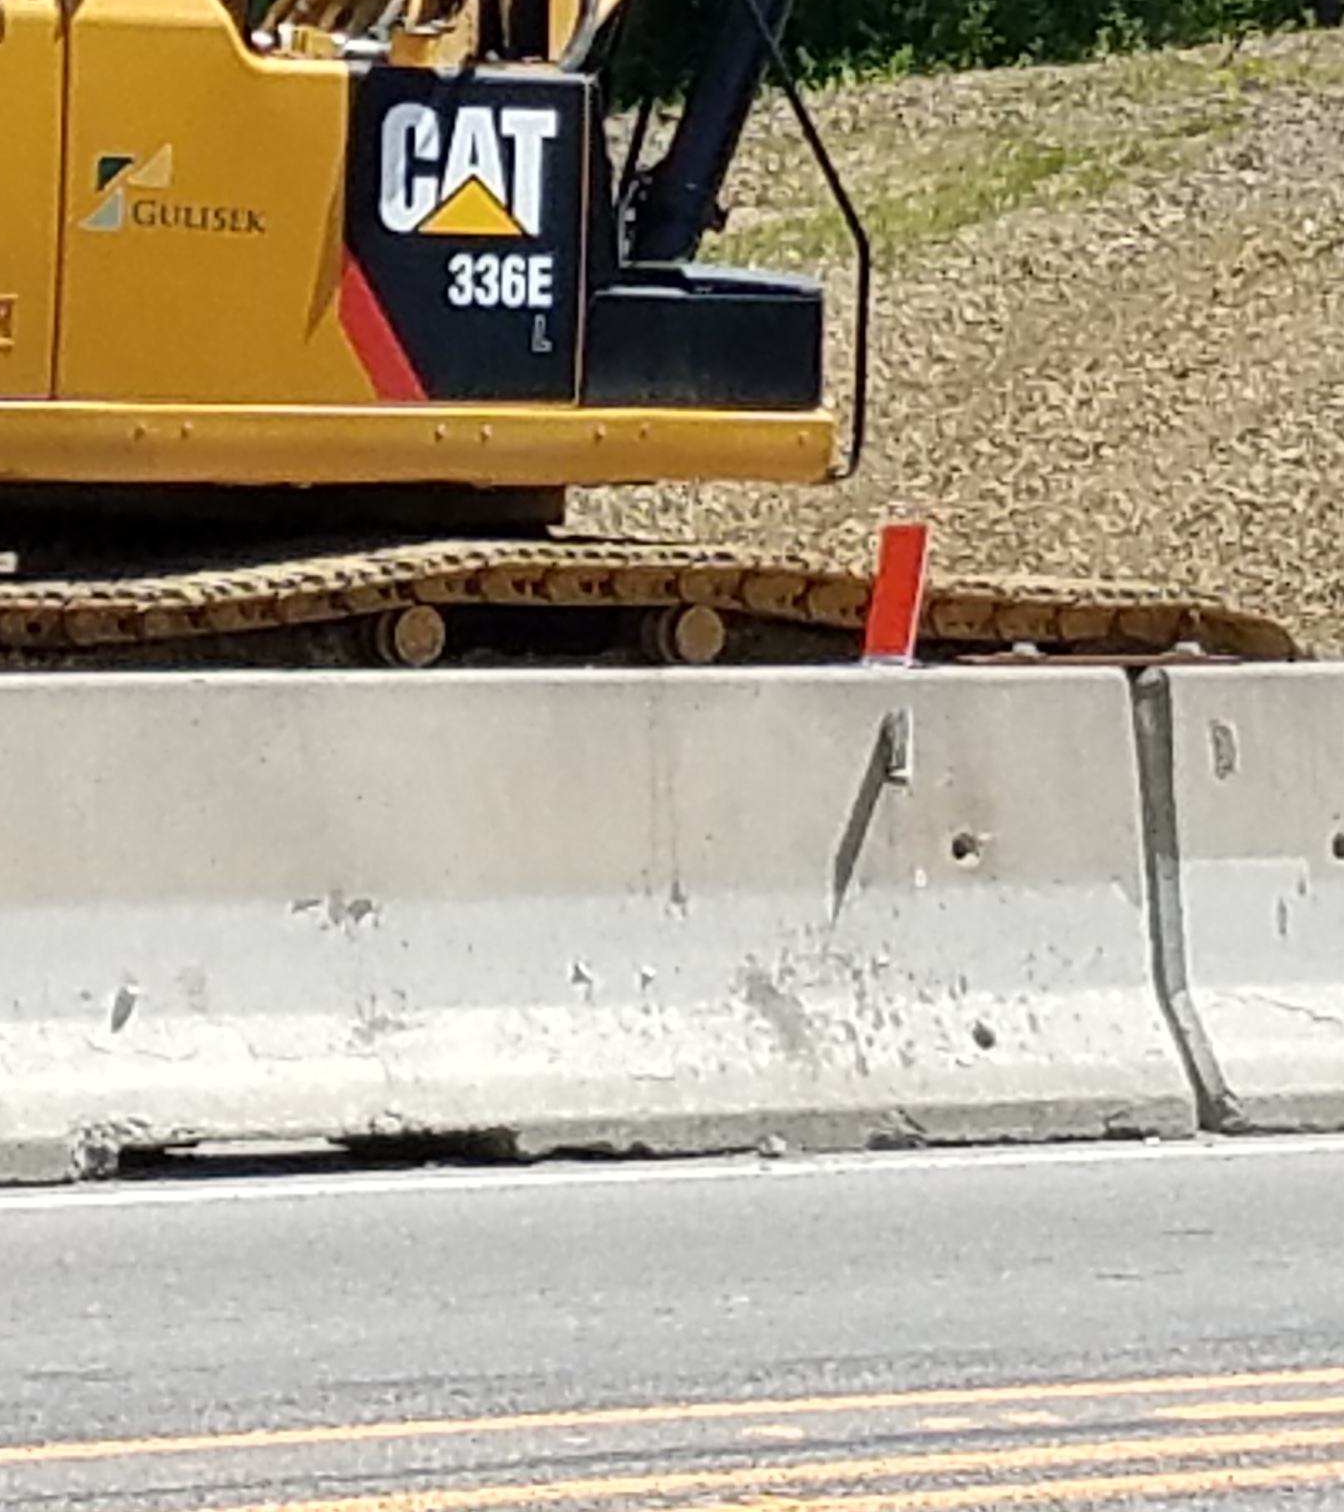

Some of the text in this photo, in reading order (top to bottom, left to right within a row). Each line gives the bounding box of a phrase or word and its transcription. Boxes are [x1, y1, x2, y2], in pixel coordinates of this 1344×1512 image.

[378, 103, 557, 238] CAT
[447, 253, 554, 309] 336E
[531, 312, 553, 353] L
